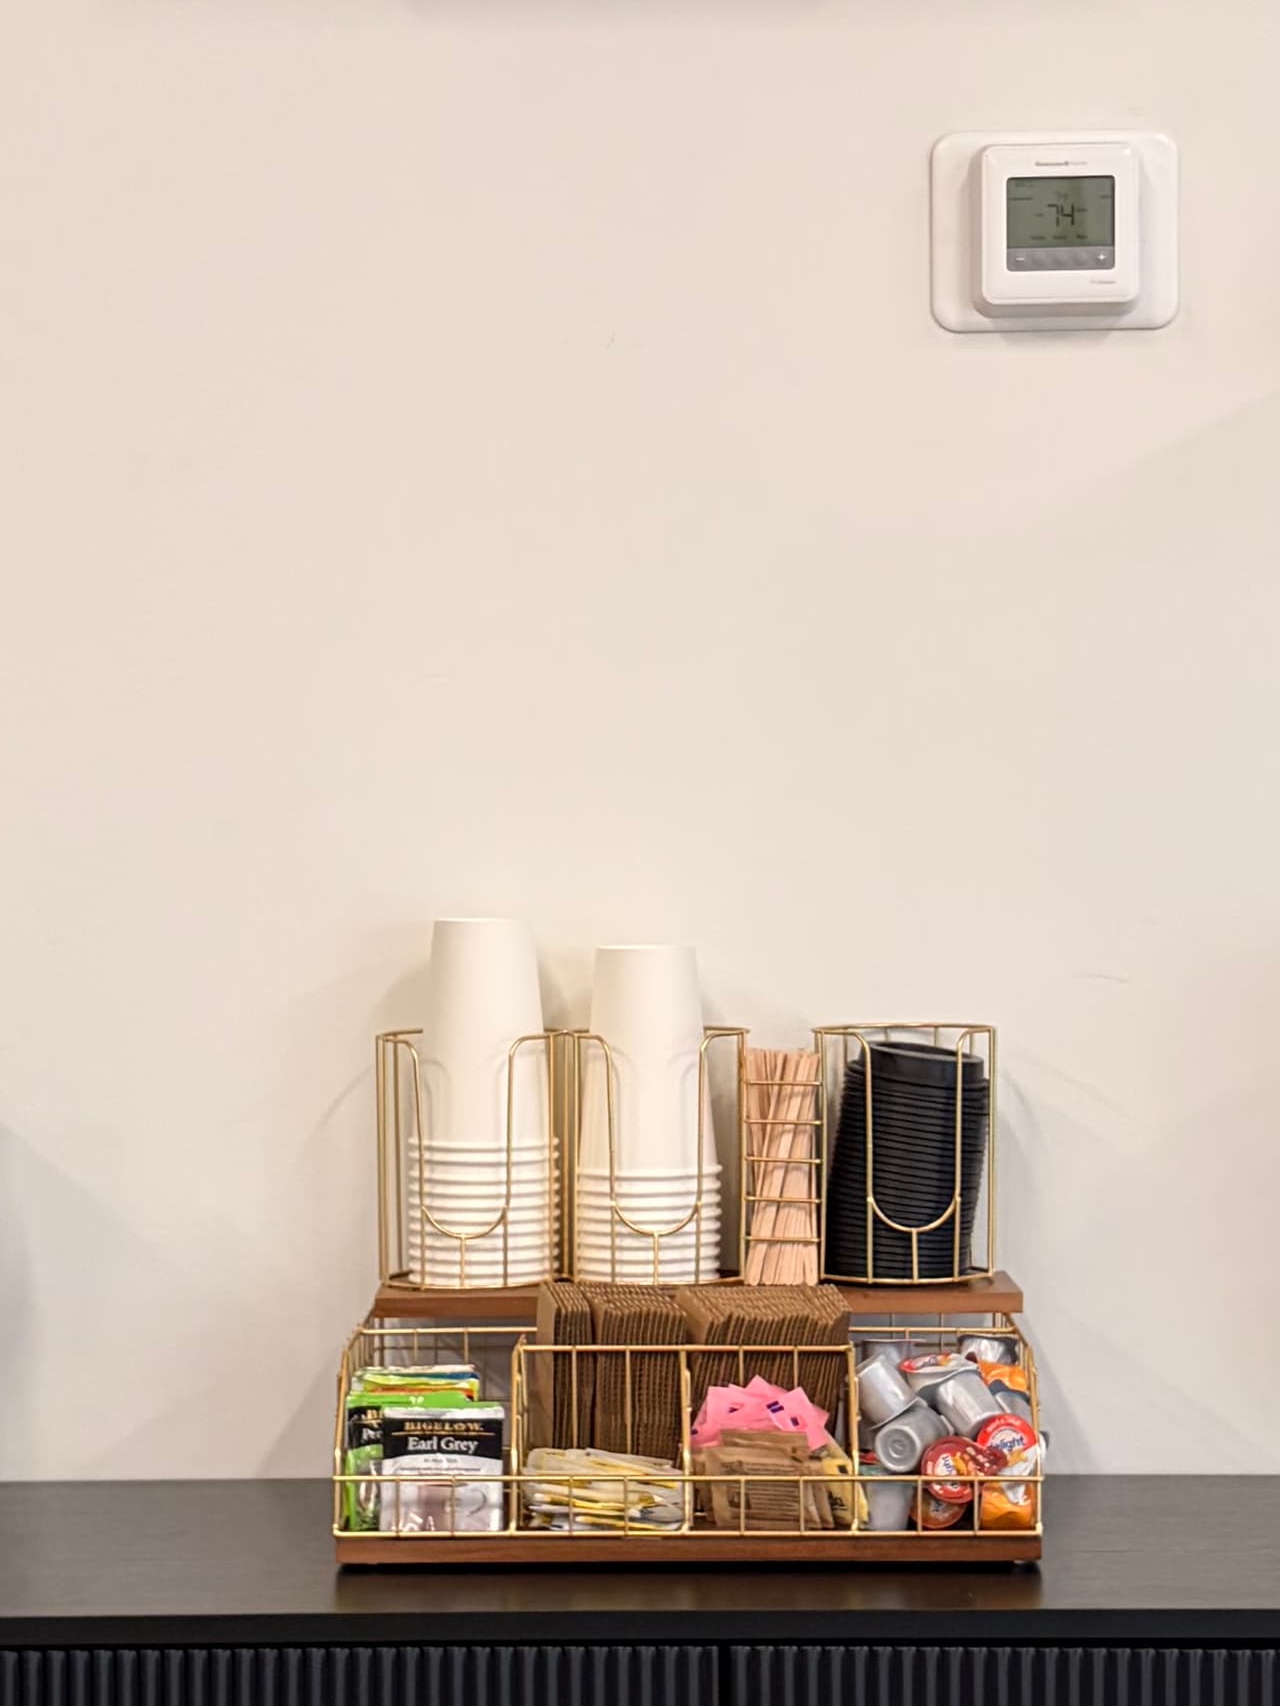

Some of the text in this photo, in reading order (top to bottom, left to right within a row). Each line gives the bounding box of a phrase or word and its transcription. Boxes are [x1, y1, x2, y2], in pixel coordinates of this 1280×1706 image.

[1046, 203, 1075, 227] 74
[403, 1421, 481, 1431] BIGELOW
[407, 1436, 479, 1455] Earl Grey
